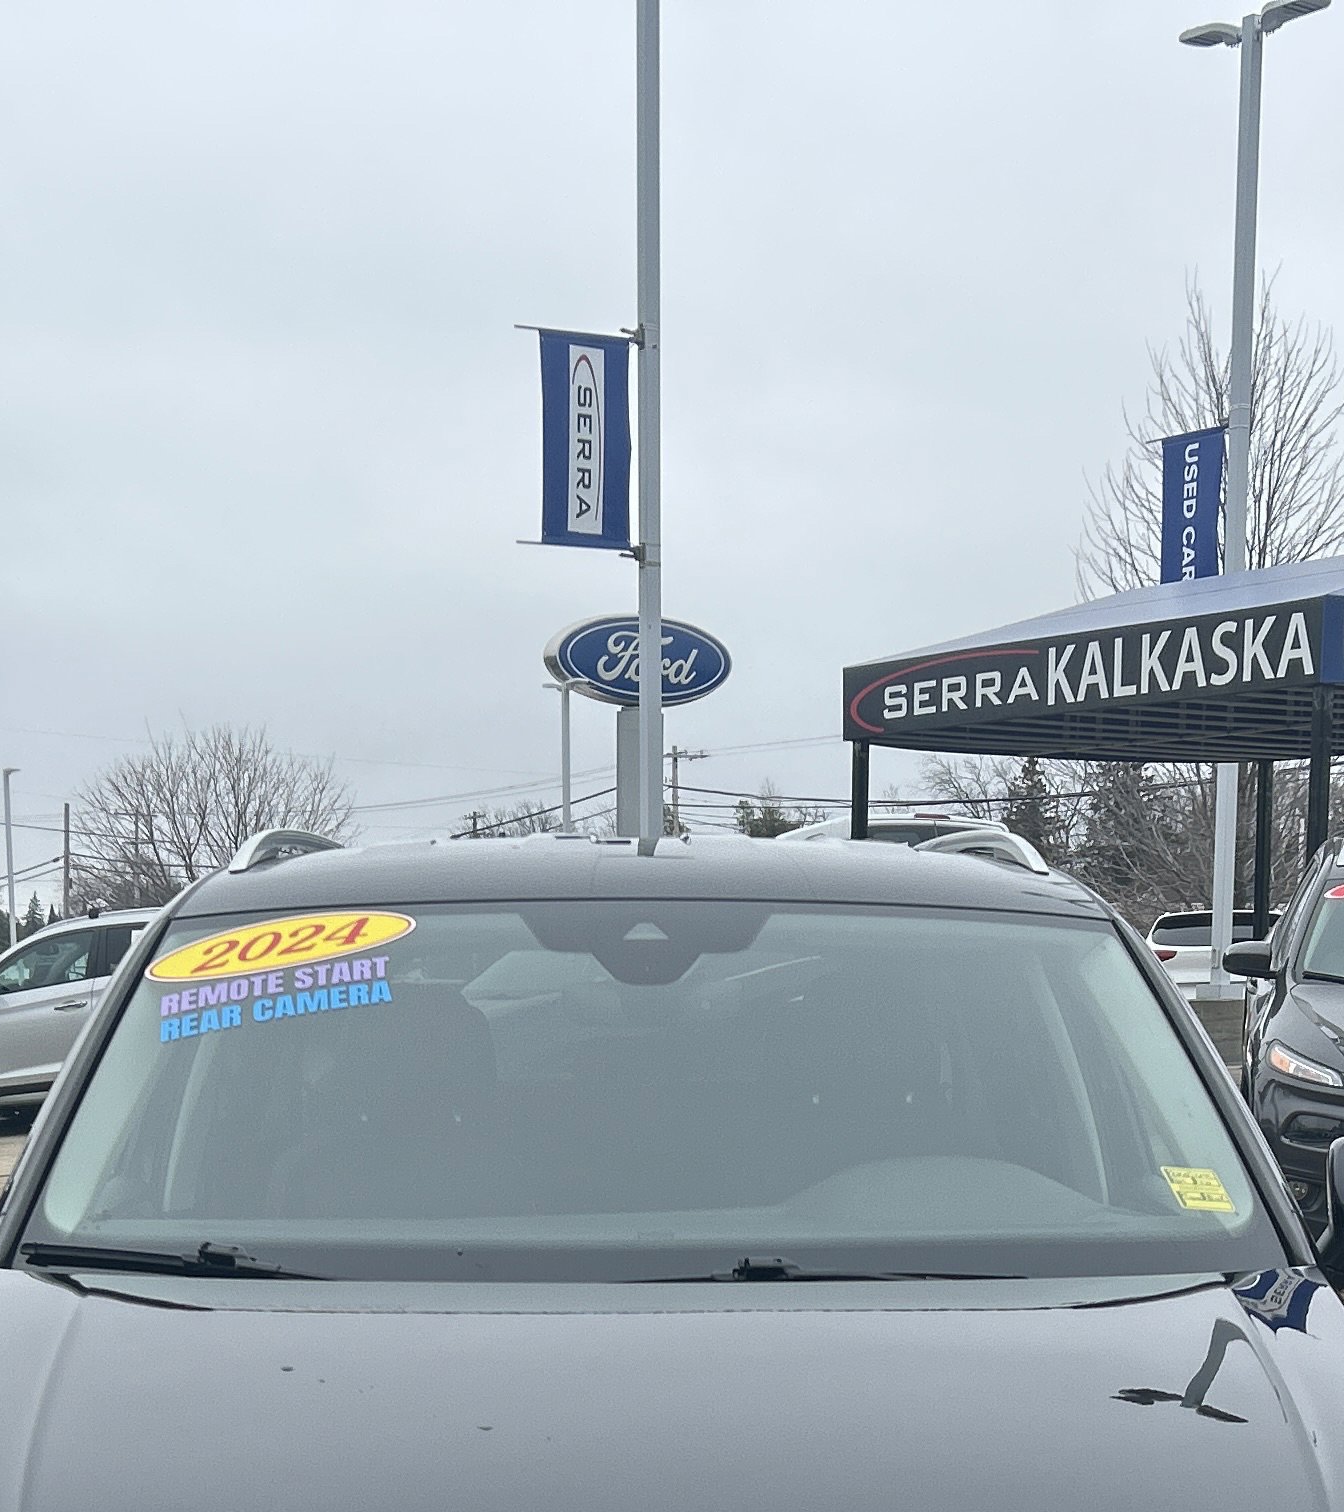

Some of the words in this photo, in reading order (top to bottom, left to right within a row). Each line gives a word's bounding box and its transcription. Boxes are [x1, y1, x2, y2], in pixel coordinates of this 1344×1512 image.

[575, 384, 593, 519] SERRA
[1182, 442, 1200, 519] USED
[1181, 526, 1197, 582] CAR
[883, 665, 1040, 719] SERRA
[1047, 612, 1315, 706] KALKASKA
[190, 917, 370, 975] 2024
[160, 972, 284, 1017] REMOTE
[294, 956, 390, 990] START
[160, 1004, 243, 1043] REAR
[253, 980, 393, 1022] CAMERA
